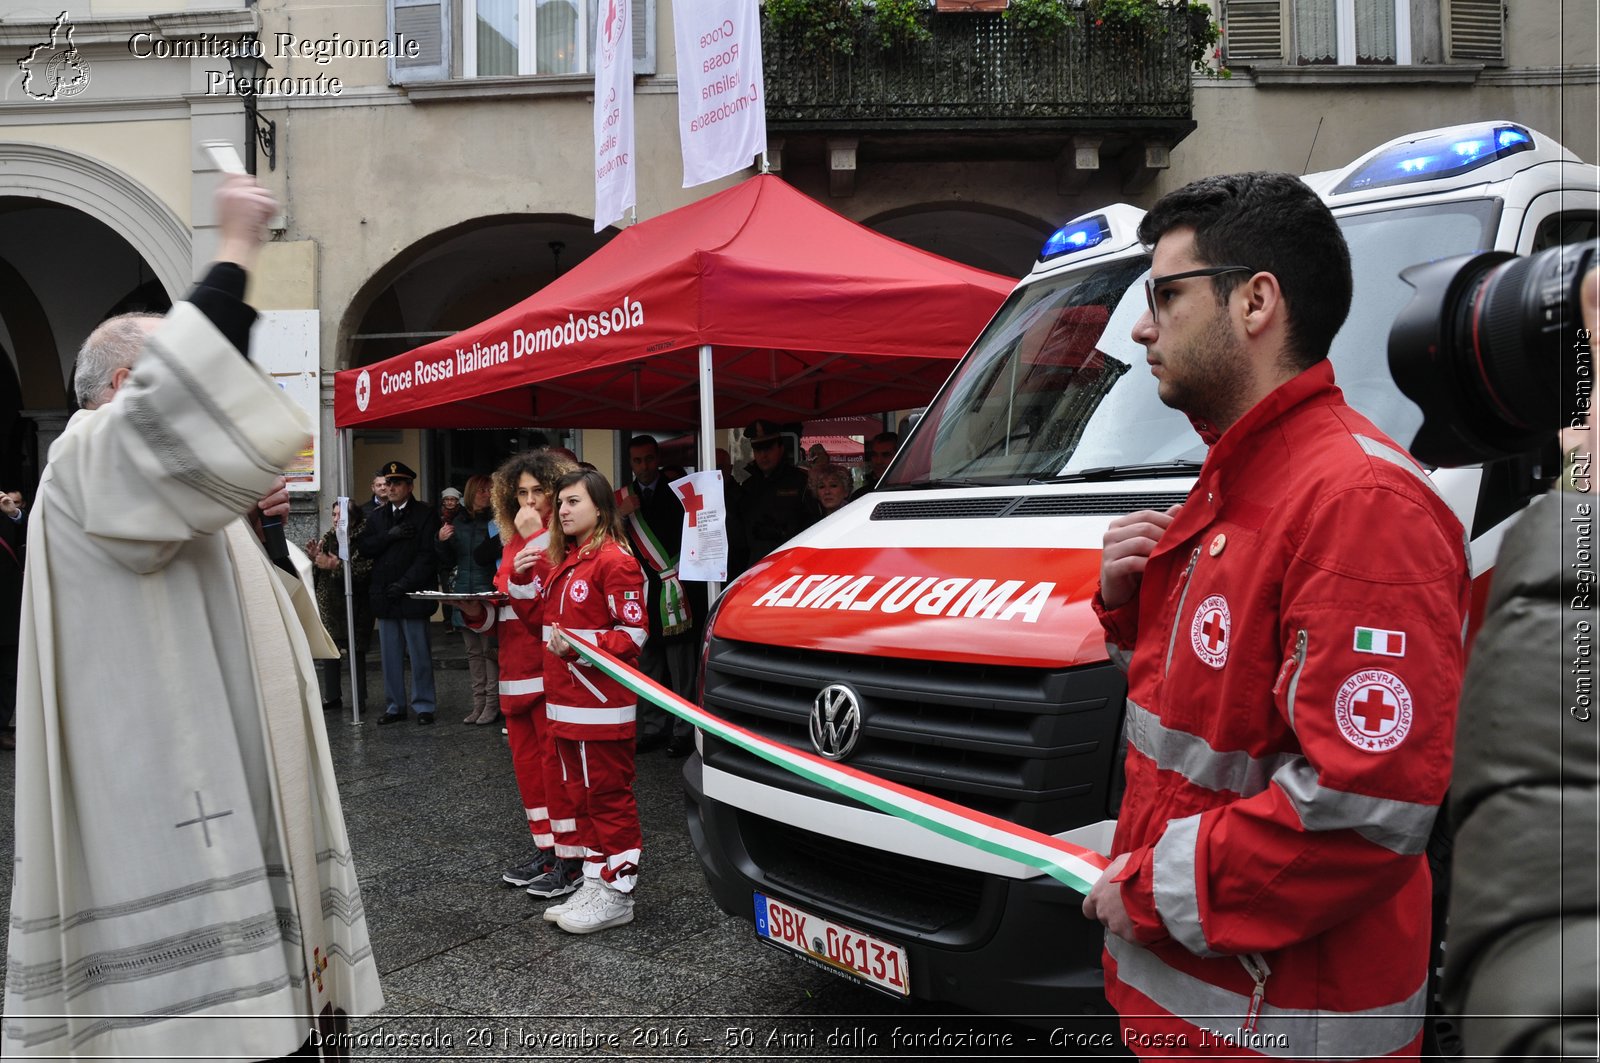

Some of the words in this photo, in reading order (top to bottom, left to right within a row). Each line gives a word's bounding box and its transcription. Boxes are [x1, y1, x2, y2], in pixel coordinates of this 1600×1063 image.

[381, 370, 412, 395] Croce
[414, 358, 454, 386] Rossa
[455, 340, 509, 375] Italiana
[512, 296, 645, 359] Domodossola
[1346, 679, 1358, 690] DI
[1356, 672, 1394, 687] GINEVRA
[1393, 683, 1405, 697] 22
[1338, 688, 1365, 746] CONVENZIONE
[1396, 697, 1411, 738] AGOSTO
[1378, 735, 1398, 749] 1864
[769, 903, 809, 950] SBK
[826, 926, 904, 988] 06131
[794, 953, 861, 985] www.ambulanzmobile.eu
